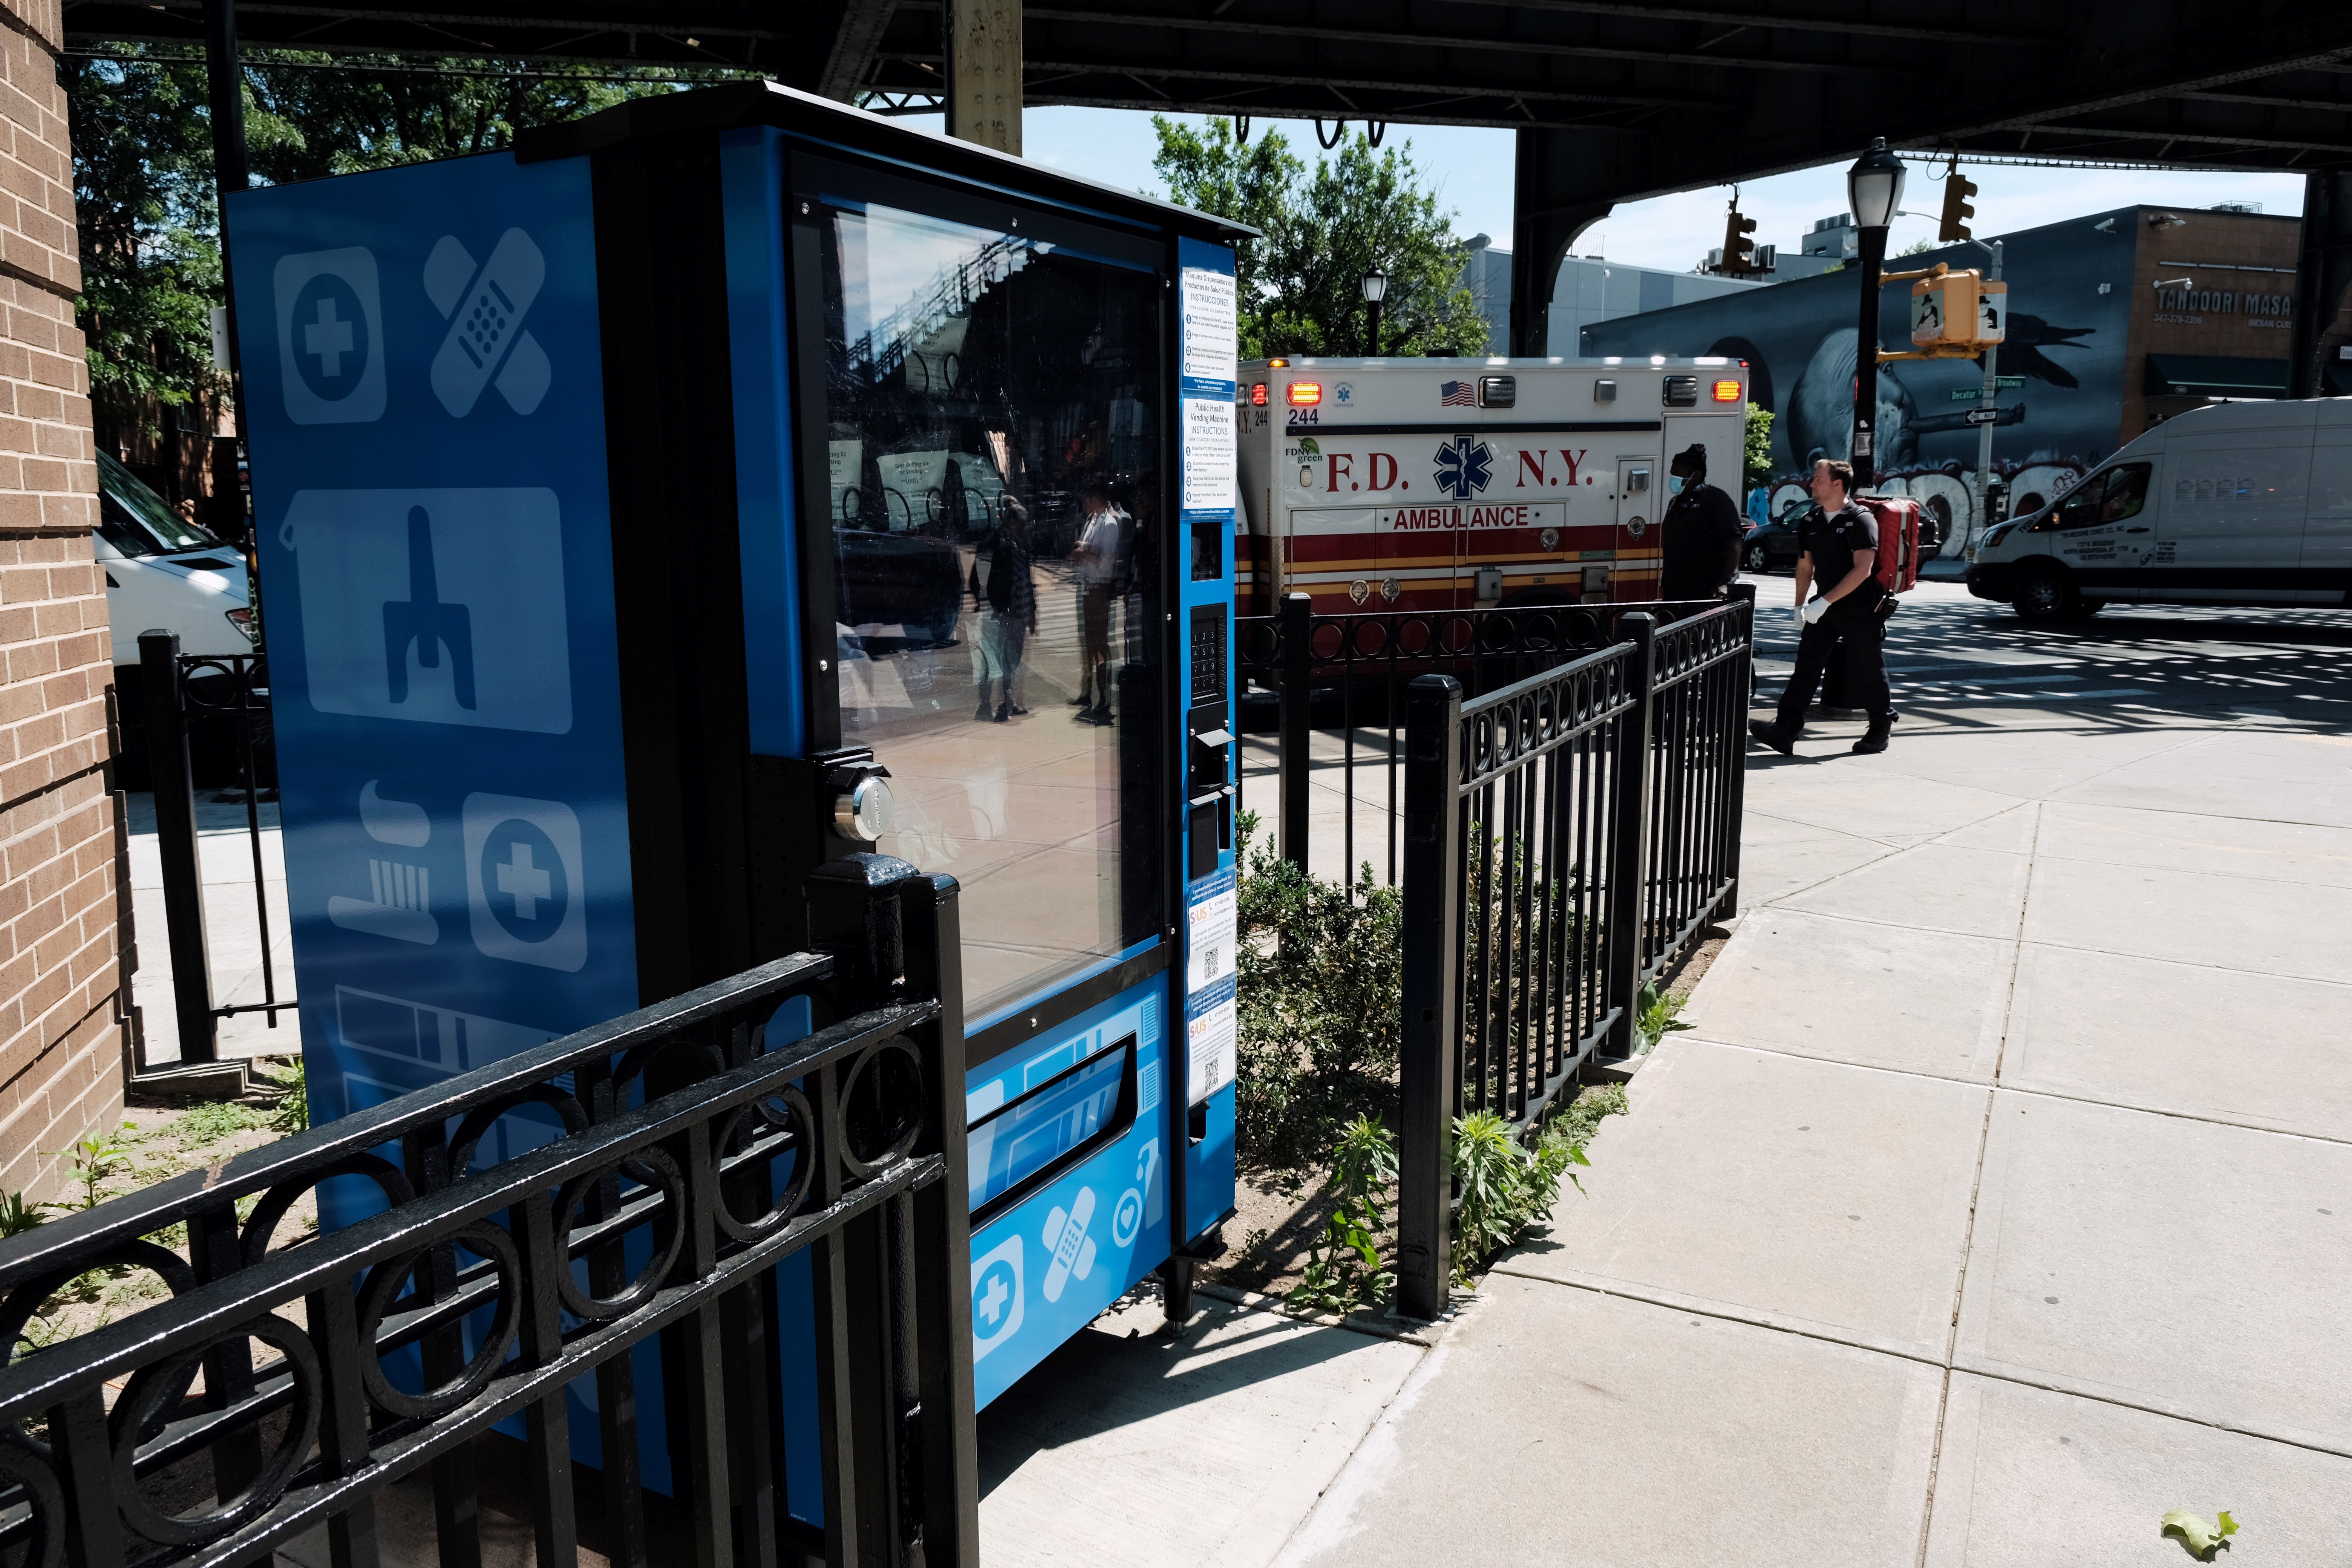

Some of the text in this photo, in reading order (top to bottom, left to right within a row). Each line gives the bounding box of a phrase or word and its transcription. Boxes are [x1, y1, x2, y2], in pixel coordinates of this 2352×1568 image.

[1185, 281, 1204, 290] Productos
[1204, 275, 1227, 285] Dispensadora
[1191, 292, 1229, 307] INSTRUCCIONES
[2158, 289, 2239, 313] TANDOORI
[2248, 319, 2274, 328] INDIAN
[1998, 378, 2022, 389] Broadway
[1952, 391, 1976, 400] Decatur
[1196, 403, 1224, 413] Public Health
[1191, 413, 1228, 424] Vending Machine
[1255, 410, 1268, 426] 244
[1289, 409, 1318, 425] 244
[1191, 426, 1228, 435] INSTRUCTIONS
[1298, 455, 1322, 464] green
[1326, 449, 1593, 492] F.D. N.Y.
[1393, 506, 1528, 530] AMBULANCE
